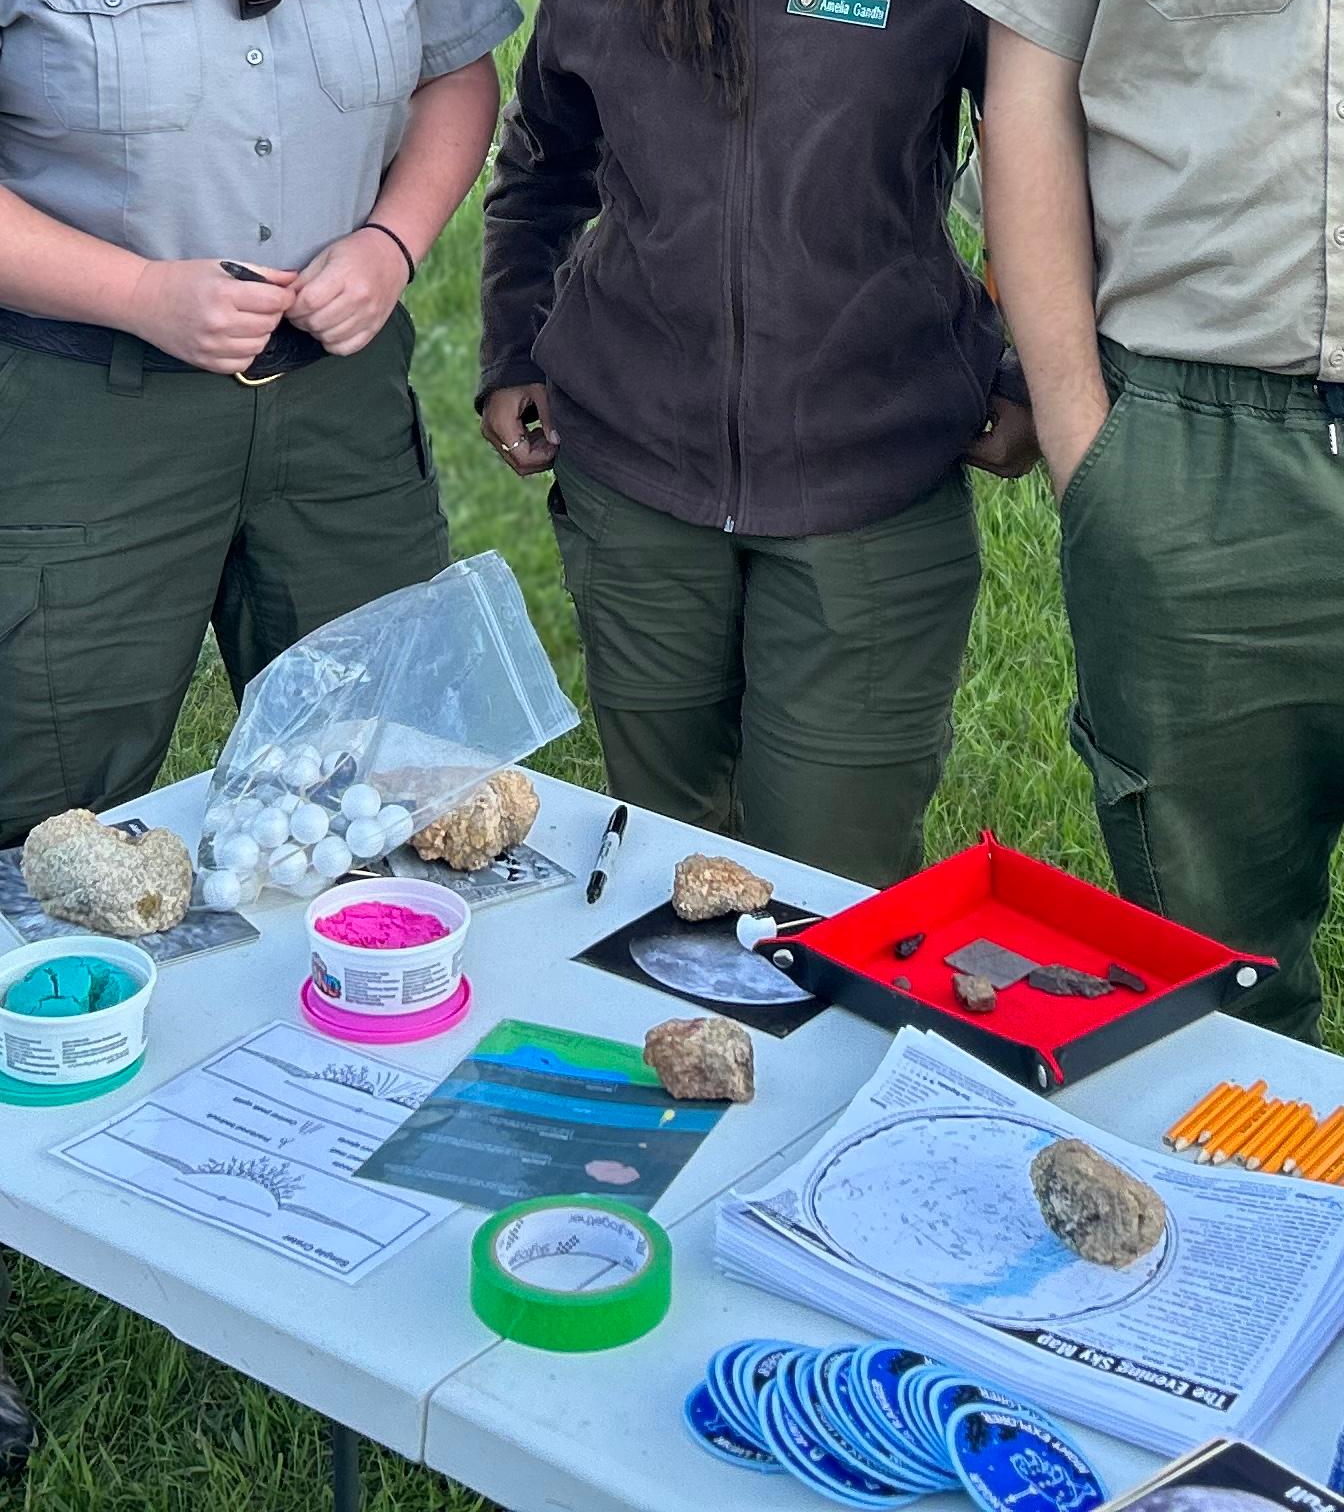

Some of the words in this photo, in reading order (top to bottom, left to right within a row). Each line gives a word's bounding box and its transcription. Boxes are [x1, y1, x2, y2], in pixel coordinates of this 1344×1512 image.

[1036, 1333, 1078, 1358] Map
[1078, 1348, 1115, 1371] Sky
[1114, 1359, 1189, 1396] Evening
[1191, 1385, 1227, 1409] The
